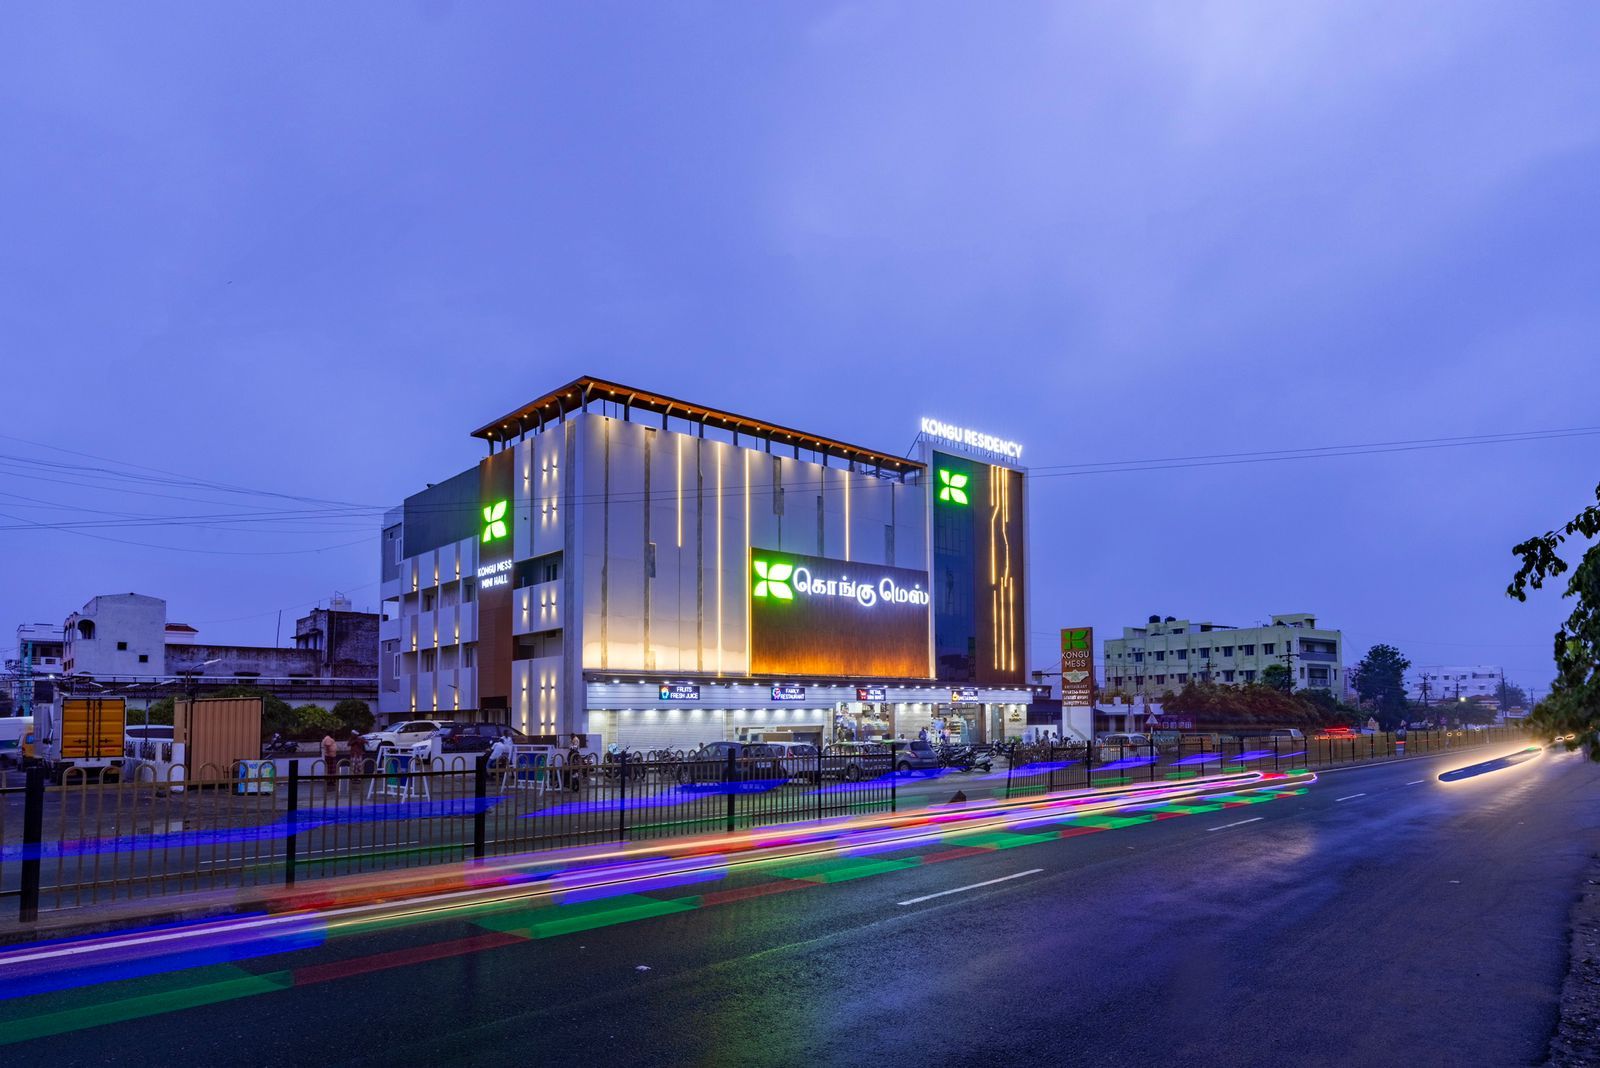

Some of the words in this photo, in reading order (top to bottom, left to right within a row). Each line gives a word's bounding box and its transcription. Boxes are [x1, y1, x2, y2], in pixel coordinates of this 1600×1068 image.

[921, 417, 962, 441] KONGU
[964, 429, 1022, 458] RESIDENCY
[478, 563, 496, 577] KONGU
[497, 559, 512, 572] MESS
[494, 574, 508, 585] HALL
[793, 567, 877, 607] கொங்கு
[879, 578, 929, 605] மெஸ்
[1062, 651, 1089, 659] KONGU
